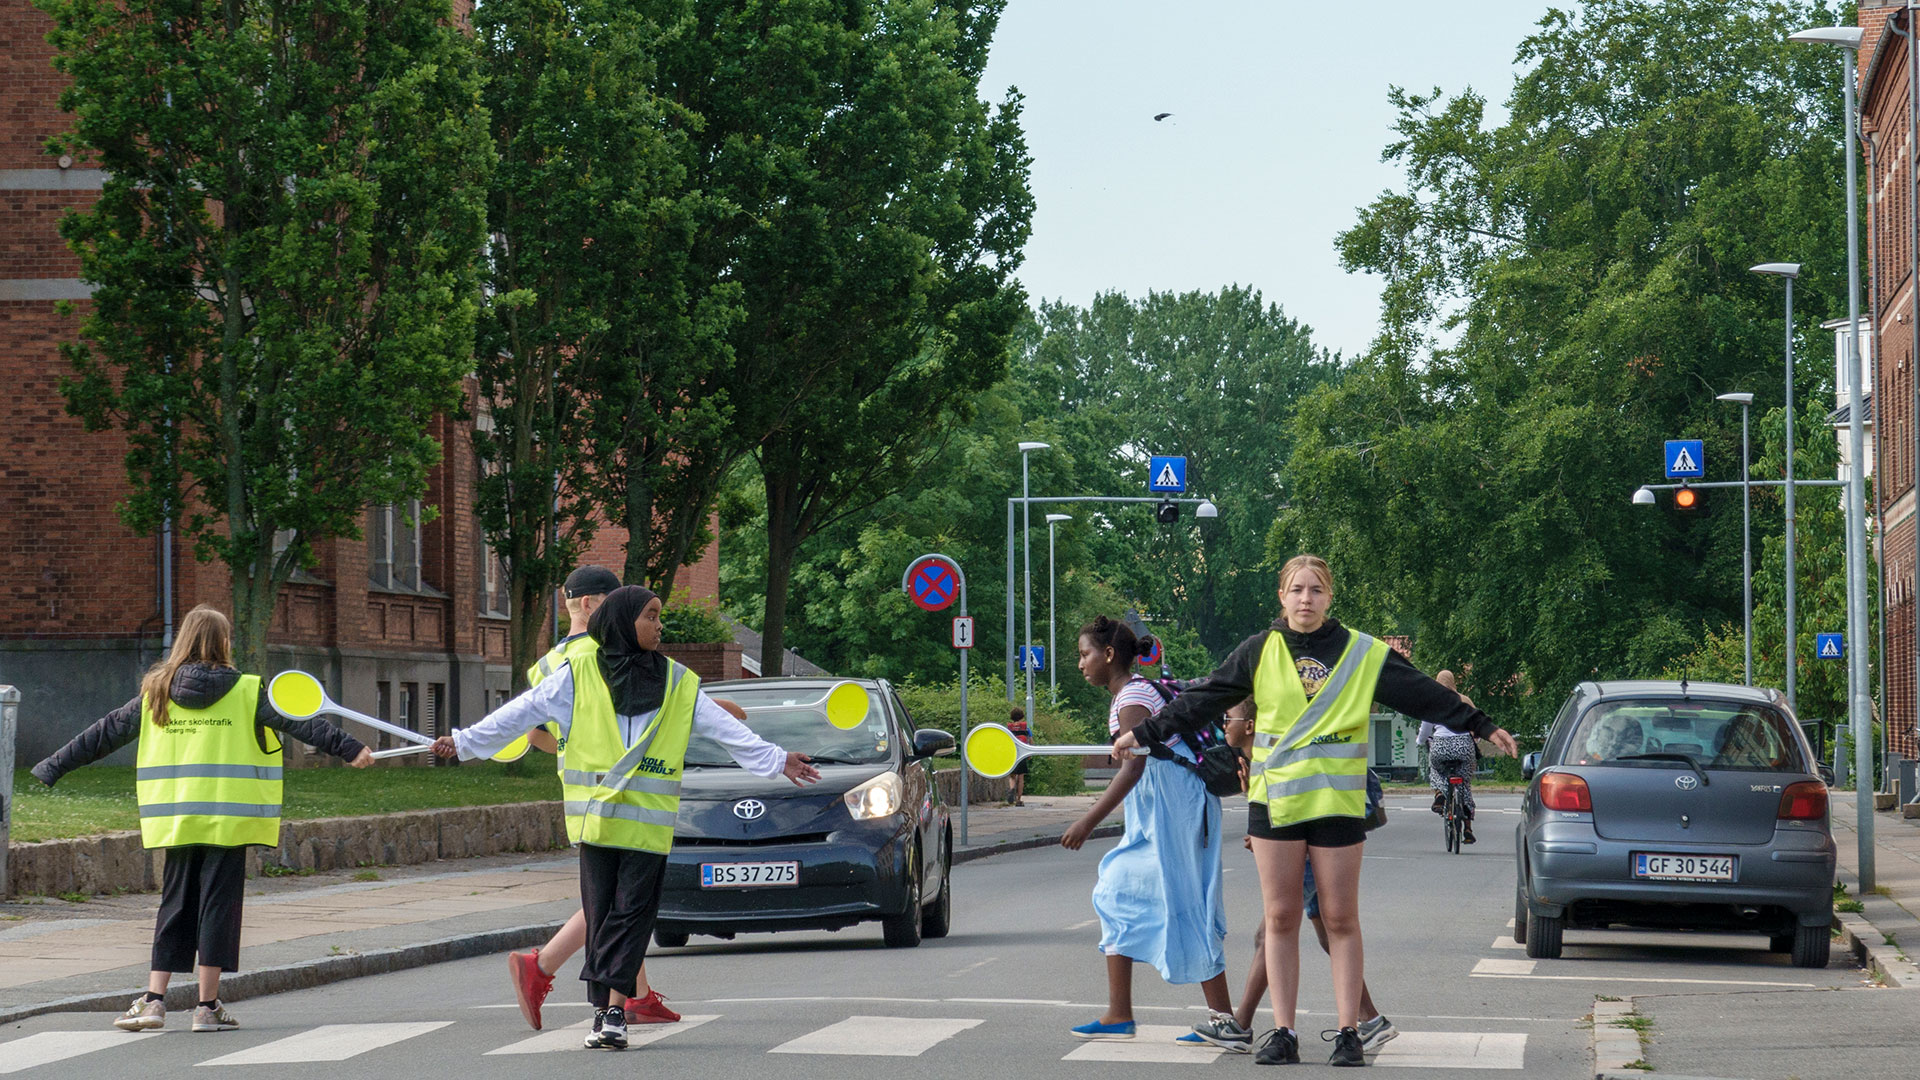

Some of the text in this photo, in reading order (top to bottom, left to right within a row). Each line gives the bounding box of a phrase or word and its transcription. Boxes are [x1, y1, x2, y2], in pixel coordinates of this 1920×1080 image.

[163, 718, 233, 726] kker skoletrafik
[641, 756, 666, 766] KOLE
[1649, 858, 1670, 873] GF
[1675, 858, 1695, 874] 30
[1699, 859, 1730, 875] 544
[714, 867, 736, 883] BS
[740, 866, 760, 882] 37
[764, 866, 795, 881] 275
